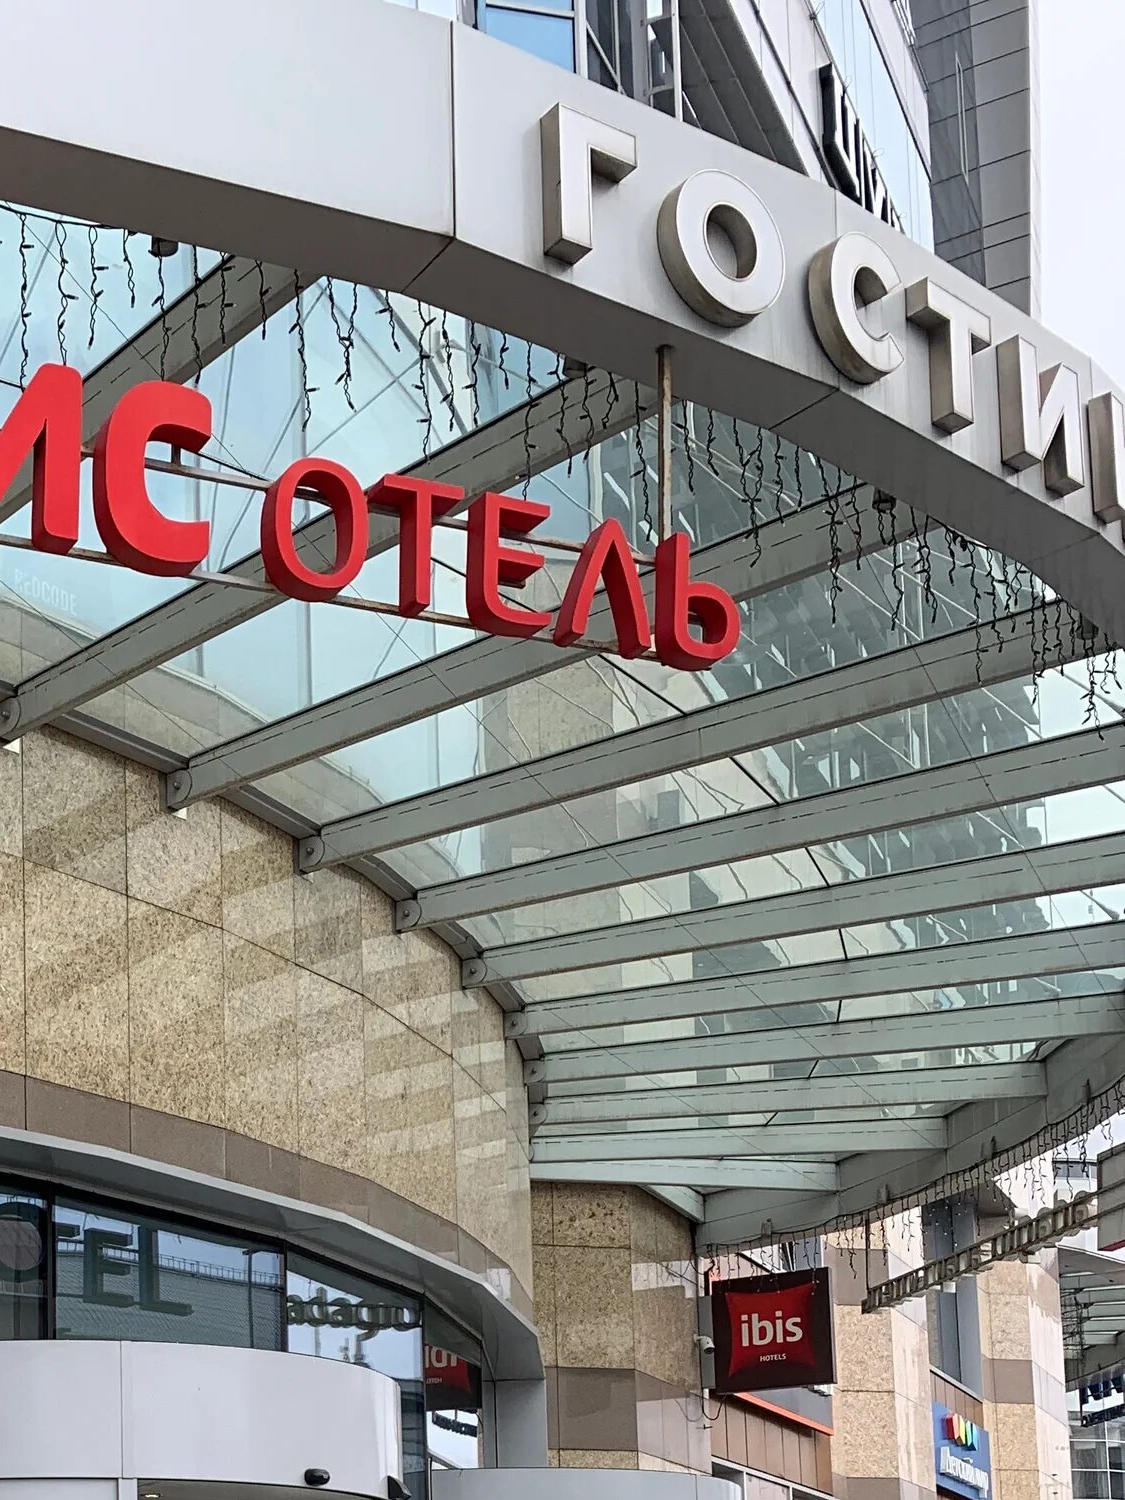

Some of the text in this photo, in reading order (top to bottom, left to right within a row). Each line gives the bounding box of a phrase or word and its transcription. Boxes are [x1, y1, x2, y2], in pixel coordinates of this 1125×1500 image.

[261, 457, 741, 672] ОТЕЛЬ
[741, 1310, 803, 1346] ibis
[760, 1353, 787, 1362] HOTELS
